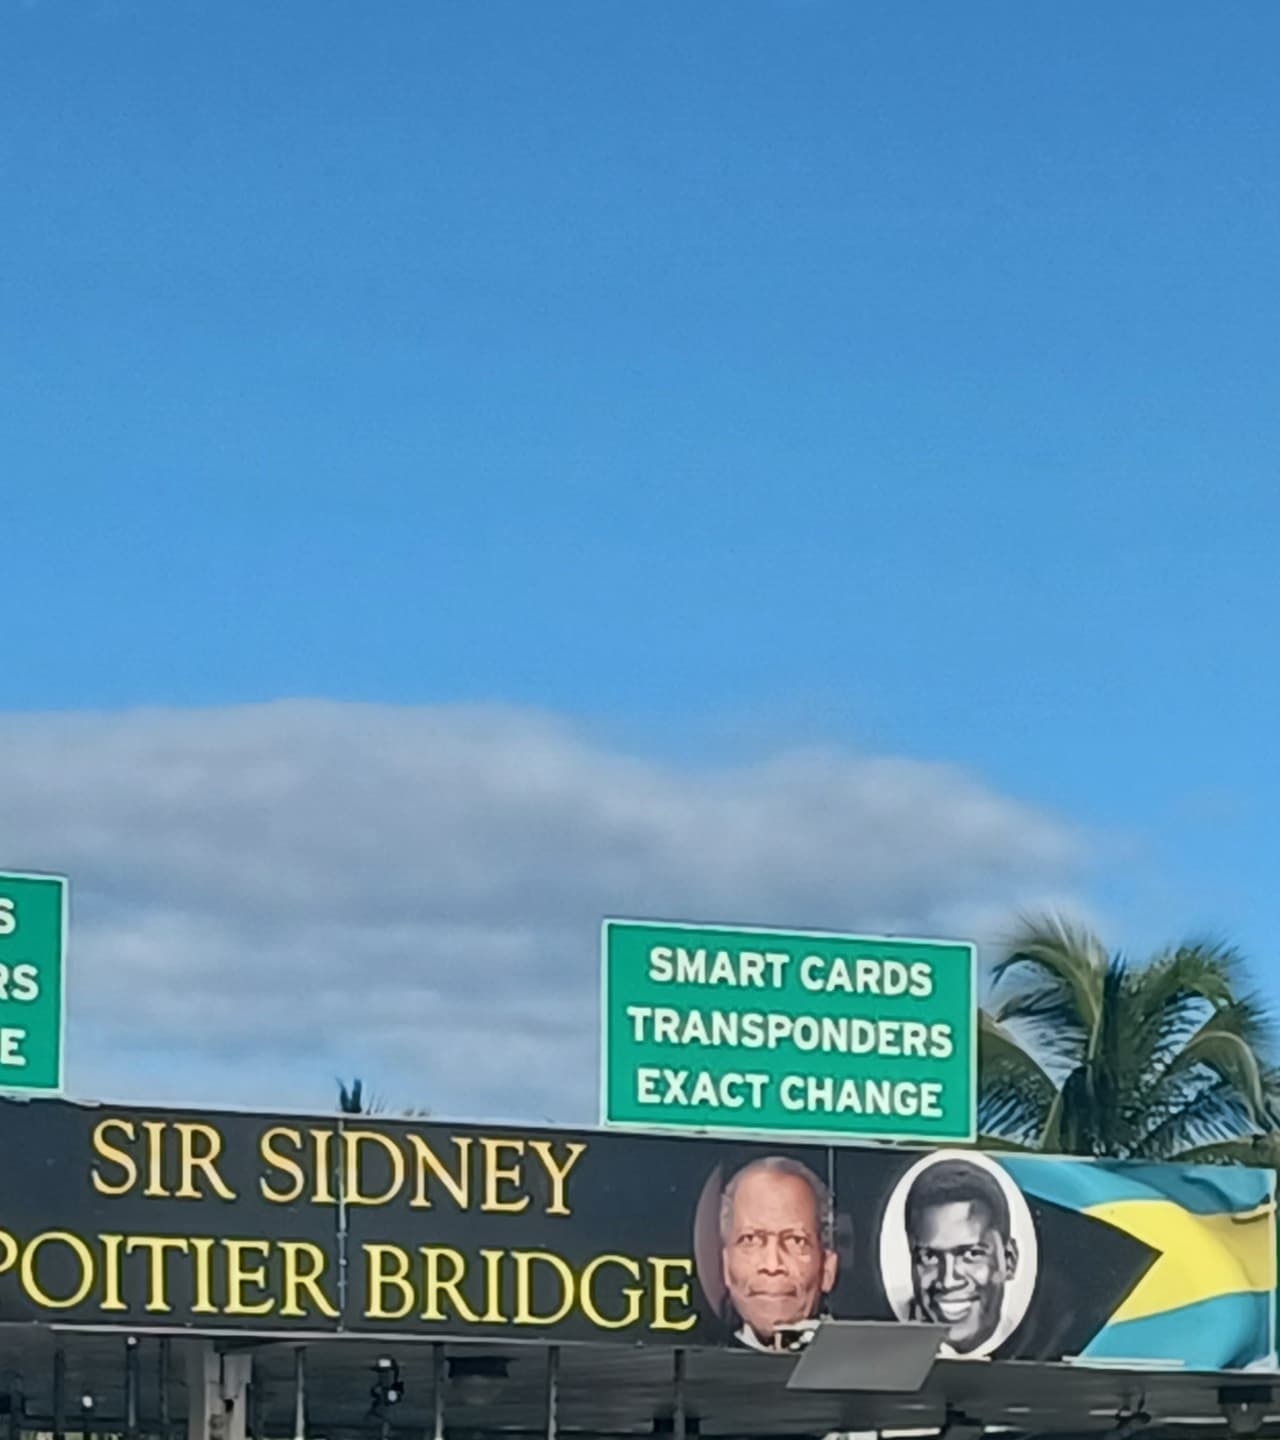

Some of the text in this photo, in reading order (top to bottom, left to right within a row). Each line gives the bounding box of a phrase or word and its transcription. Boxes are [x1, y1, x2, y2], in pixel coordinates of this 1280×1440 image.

[649, 947, 932, 996] SMART CARDS
[627, 1006, 952, 1058] TRANSPONDERS
[637, 1067, 943, 1118] EXACT CHANGE
[90, 1118, 587, 1215] SIR SIDNEY
[362, 1242, 697, 1331] BRIDGE
